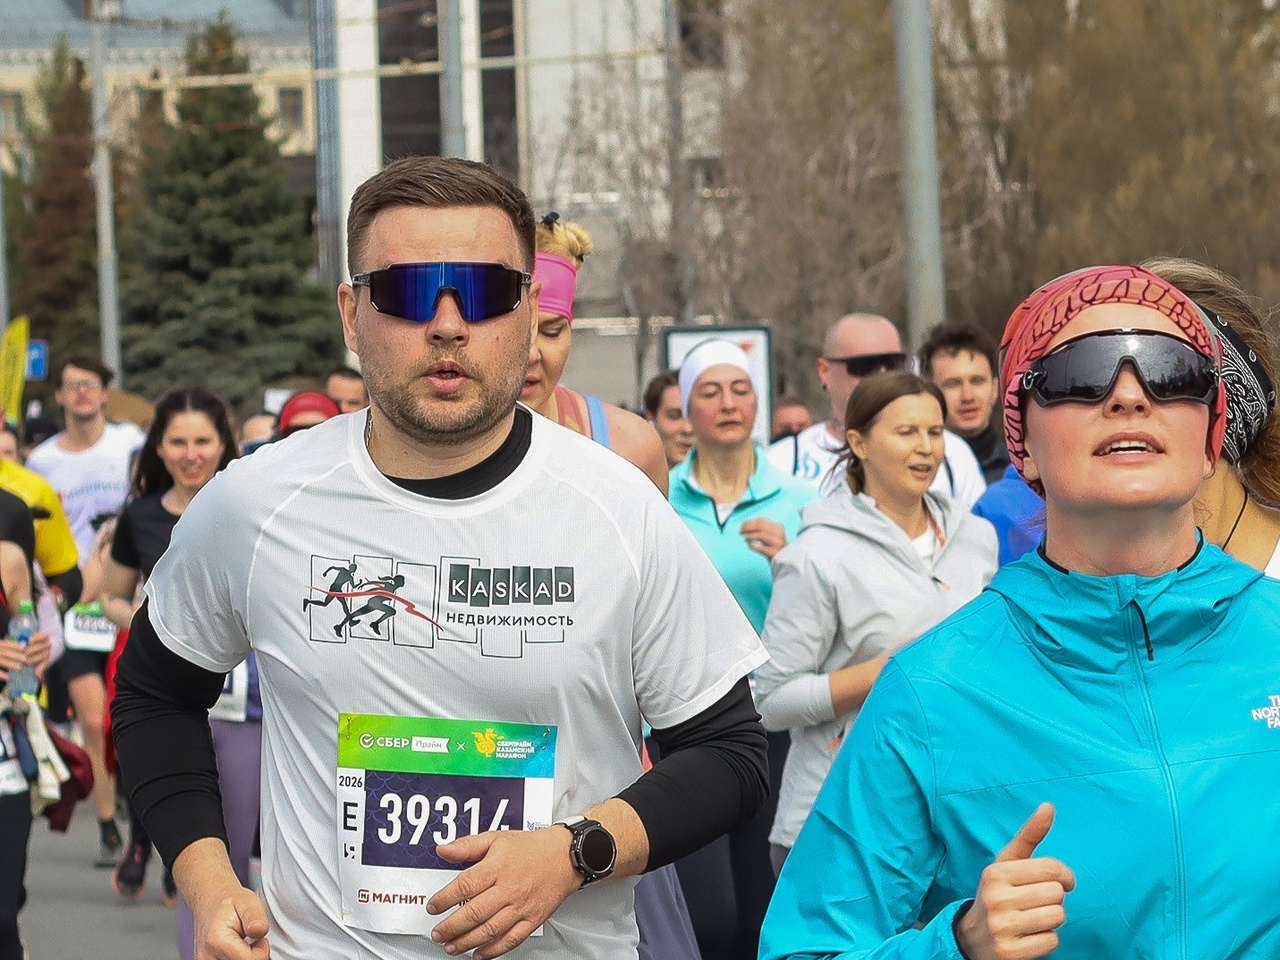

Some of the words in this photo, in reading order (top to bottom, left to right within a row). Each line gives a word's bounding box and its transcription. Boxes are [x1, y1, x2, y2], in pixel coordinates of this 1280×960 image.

[451, 579, 574, 598] KASKAD
[446, 612, 574, 626] НЕДВИЖИМОСТЬ
[376, 736, 410, 748] СБЕР
[415, 740, 442, 749] Прайм
[338, 775, 363, 788] 2026
[343, 801, 359, 831] E
[373, 892, 427, 905] МАГНИТ
